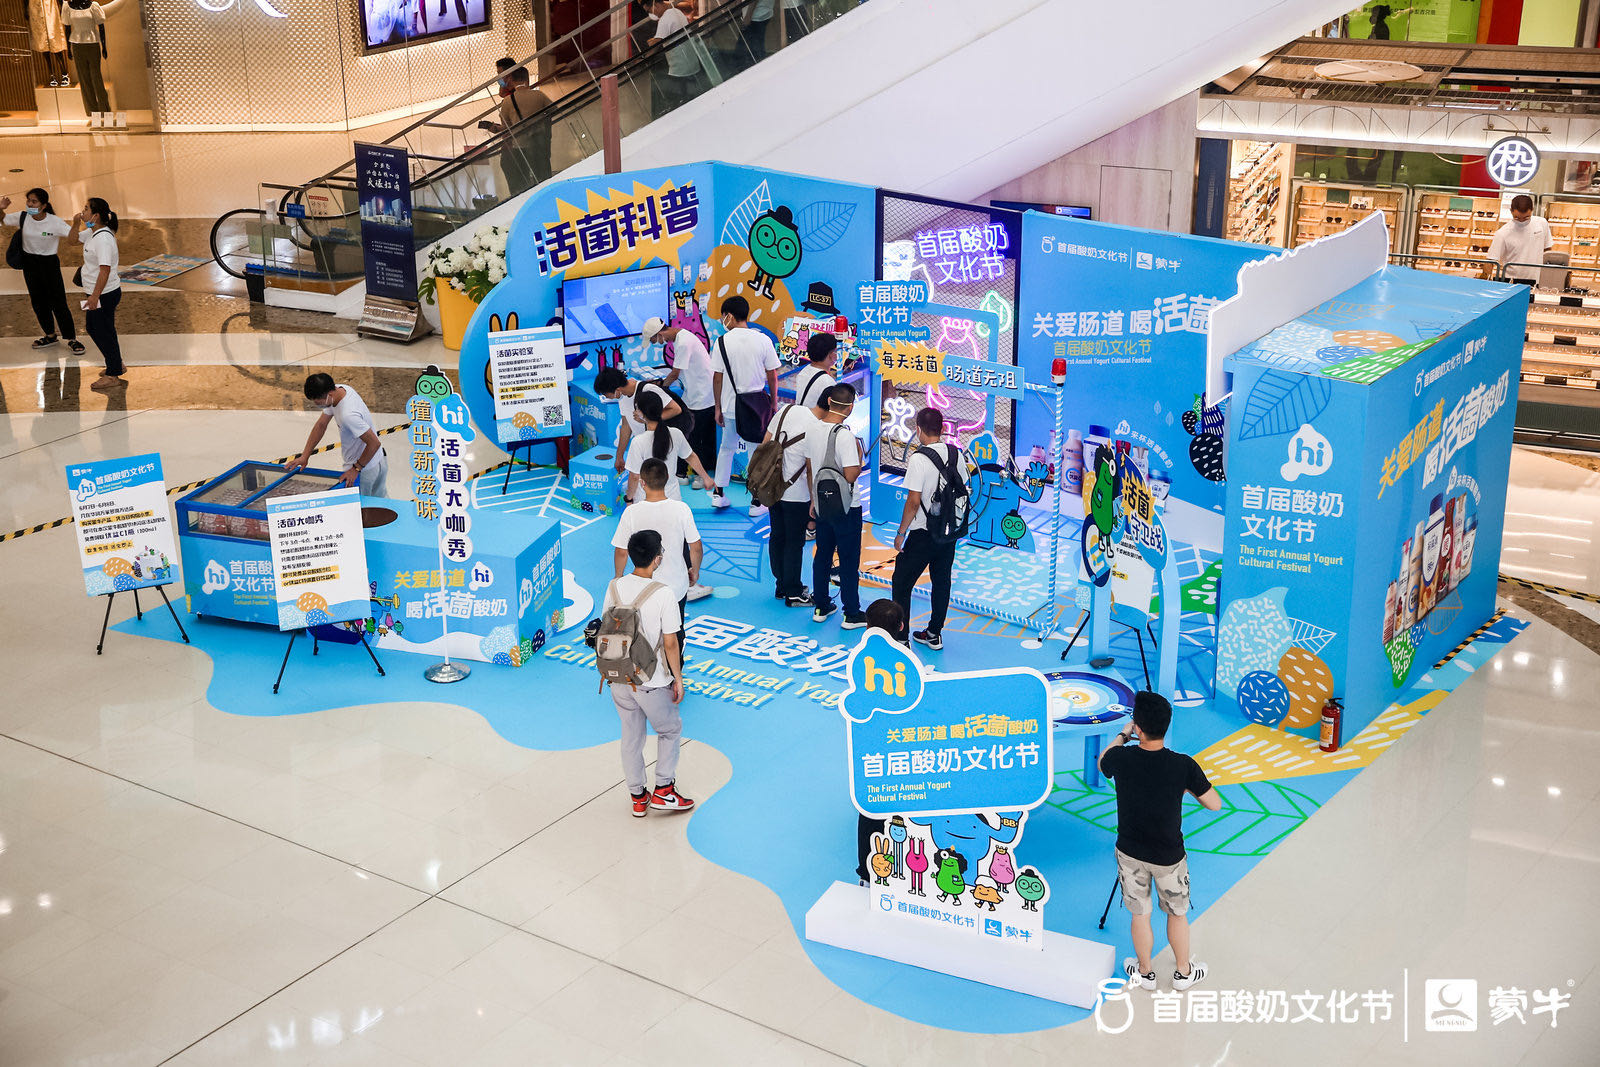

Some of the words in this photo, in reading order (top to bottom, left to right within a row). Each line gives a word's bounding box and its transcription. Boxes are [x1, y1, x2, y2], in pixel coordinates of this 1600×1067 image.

[534, 186, 699, 276] 活菌科普
[917, 223, 1008, 258] 首届酸奶
[1057, 242, 1128, 263] 首届酸奶文化节
[935, 252, 1005, 285] 文化节
[859, 285, 924, 303] 首届酸奶
[860, 306, 908, 324] 文化节
[1032, 310, 1124, 338] 关爱肠道
[908, 330, 926, 338] Yogurt
[1054, 339, 1152, 356] 首届酸奶文化节
[882, 351, 938, 372] 每天活菌
[946, 365, 1017, 389] 肠道无阻
[1424, 352, 1462, 388] 首届酸奶文化节
[442, 405, 464, 426] hi
[1422, 369, 1510, 490] 喝活菌酸奶
[409, 399, 438, 520] 撞出新滋味
[738, 442, 746, 450] hi
[974, 441, 992, 460] hi
[1295, 438, 1324, 467] hi
[1378, 398, 1445, 500] 关爱肠道
[96, 462, 155, 485] 首届酸奶文化节
[82, 484, 93, 493] hi
[440, 438, 466, 558] 活菌大咖秀
[1124, 477, 1150, 520] 活菌
[1241, 484, 1344, 518] 首届酸奶
[278, 514, 324, 528] 活菌大咖秀
[1240, 514, 1317, 544] 文化节
[1239, 556, 1274, 568] Cultural
[1276, 560, 1312, 573] Festival
[1240, 544, 1254, 554] The
[1257, 546, 1277, 558] First
[1279, 549, 1310, 561] Annual
[1314, 552, 1344, 566] Yogurt
[208, 568, 225, 585] hi
[232, 576, 275, 592] 文化节
[394, 569, 466, 589] 关爱肠道
[475, 569, 490, 583] hi
[406, 590, 508, 619] 喝活菌酸奶
[688, 659, 794, 691] Annual
[794, 682, 841, 706] Yog
[864, 656, 907, 698] hi
[886, 726, 947, 744] 关爱肠道
[950, 714, 1039, 739] 喝活菌酸奶
[862, 742, 1040, 778] 首届酸奶文化节
[868, 794, 896, 802] Cultural
[898, 792, 926, 800] Festival
[882, 784, 898, 792] First
[900, 782, 926, 790] Annual
[928, 780, 951, 790] Yogurt
[898, 901, 975, 928] 首届酸奶文化节
